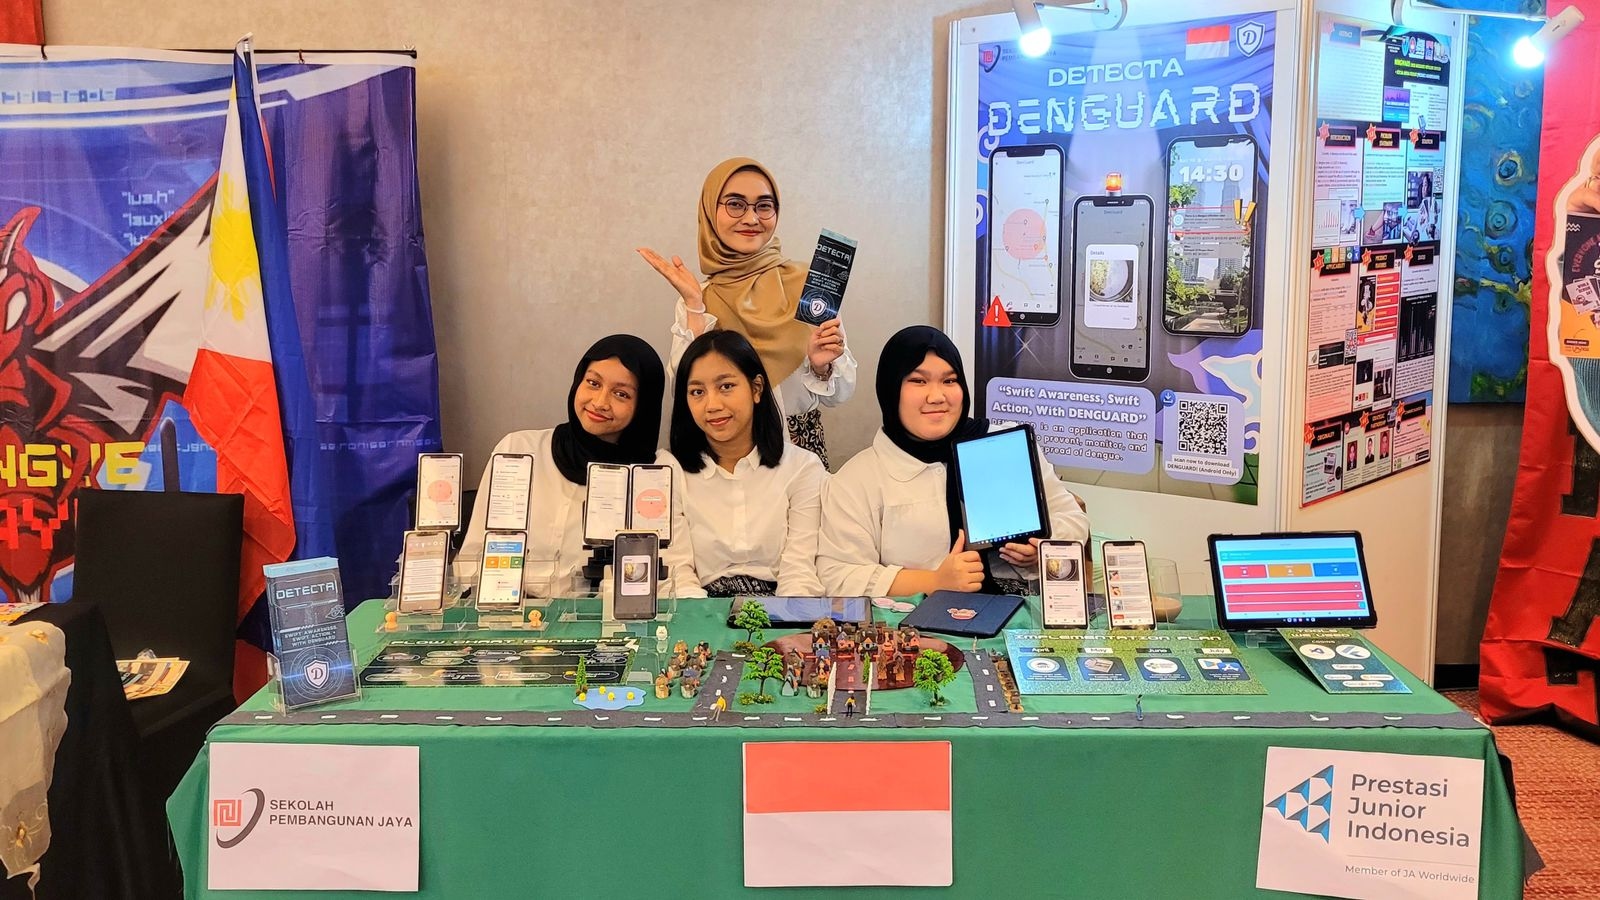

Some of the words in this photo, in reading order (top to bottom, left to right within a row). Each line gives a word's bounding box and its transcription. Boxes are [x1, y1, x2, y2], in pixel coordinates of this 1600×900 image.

[1048, 58, 1184, 87] DETECTA
[988, 83, 1261, 137] DENGUARD
[1180, 164, 1244, 182] 14:30
[816, 244, 851, 260] DETECTA
[1038, 389, 1104, 404] Awareness,
[1108, 394, 1140, 406] Swift
[992, 402, 1033, 416] Action,
[1036, 405, 1065, 417] With
[1068, 426, 1122, 438] application
[1126, 431, 1148, 440] that
[1044, 434, 1083, 446] prevent,
[1085, 438, 1126, 450] monitor,
[1128, 442, 1148, 452] and
[1073, 448, 1082, 456] of
[1085, 450, 1124, 462] dengue.
[1204, 460, 1230, 468] download
[276, 582, 335, 600] DETECTA
[1351, 774, 1448, 798] Prestasi
[270, 800, 334, 811] SEKOLAH
[1348, 797, 1426, 820] Junior
[270, 815, 374, 826] PEMBANGUNAN
[378, 816, 412, 828] JAYA
[1348, 820, 1470, 848] Indonesia
[1345, 864, 1388, 877] Member
[1390, 867, 1401, 878] of
[1402, 868, 1416, 878] JA
[1418, 870, 1475, 884] Worldwide
